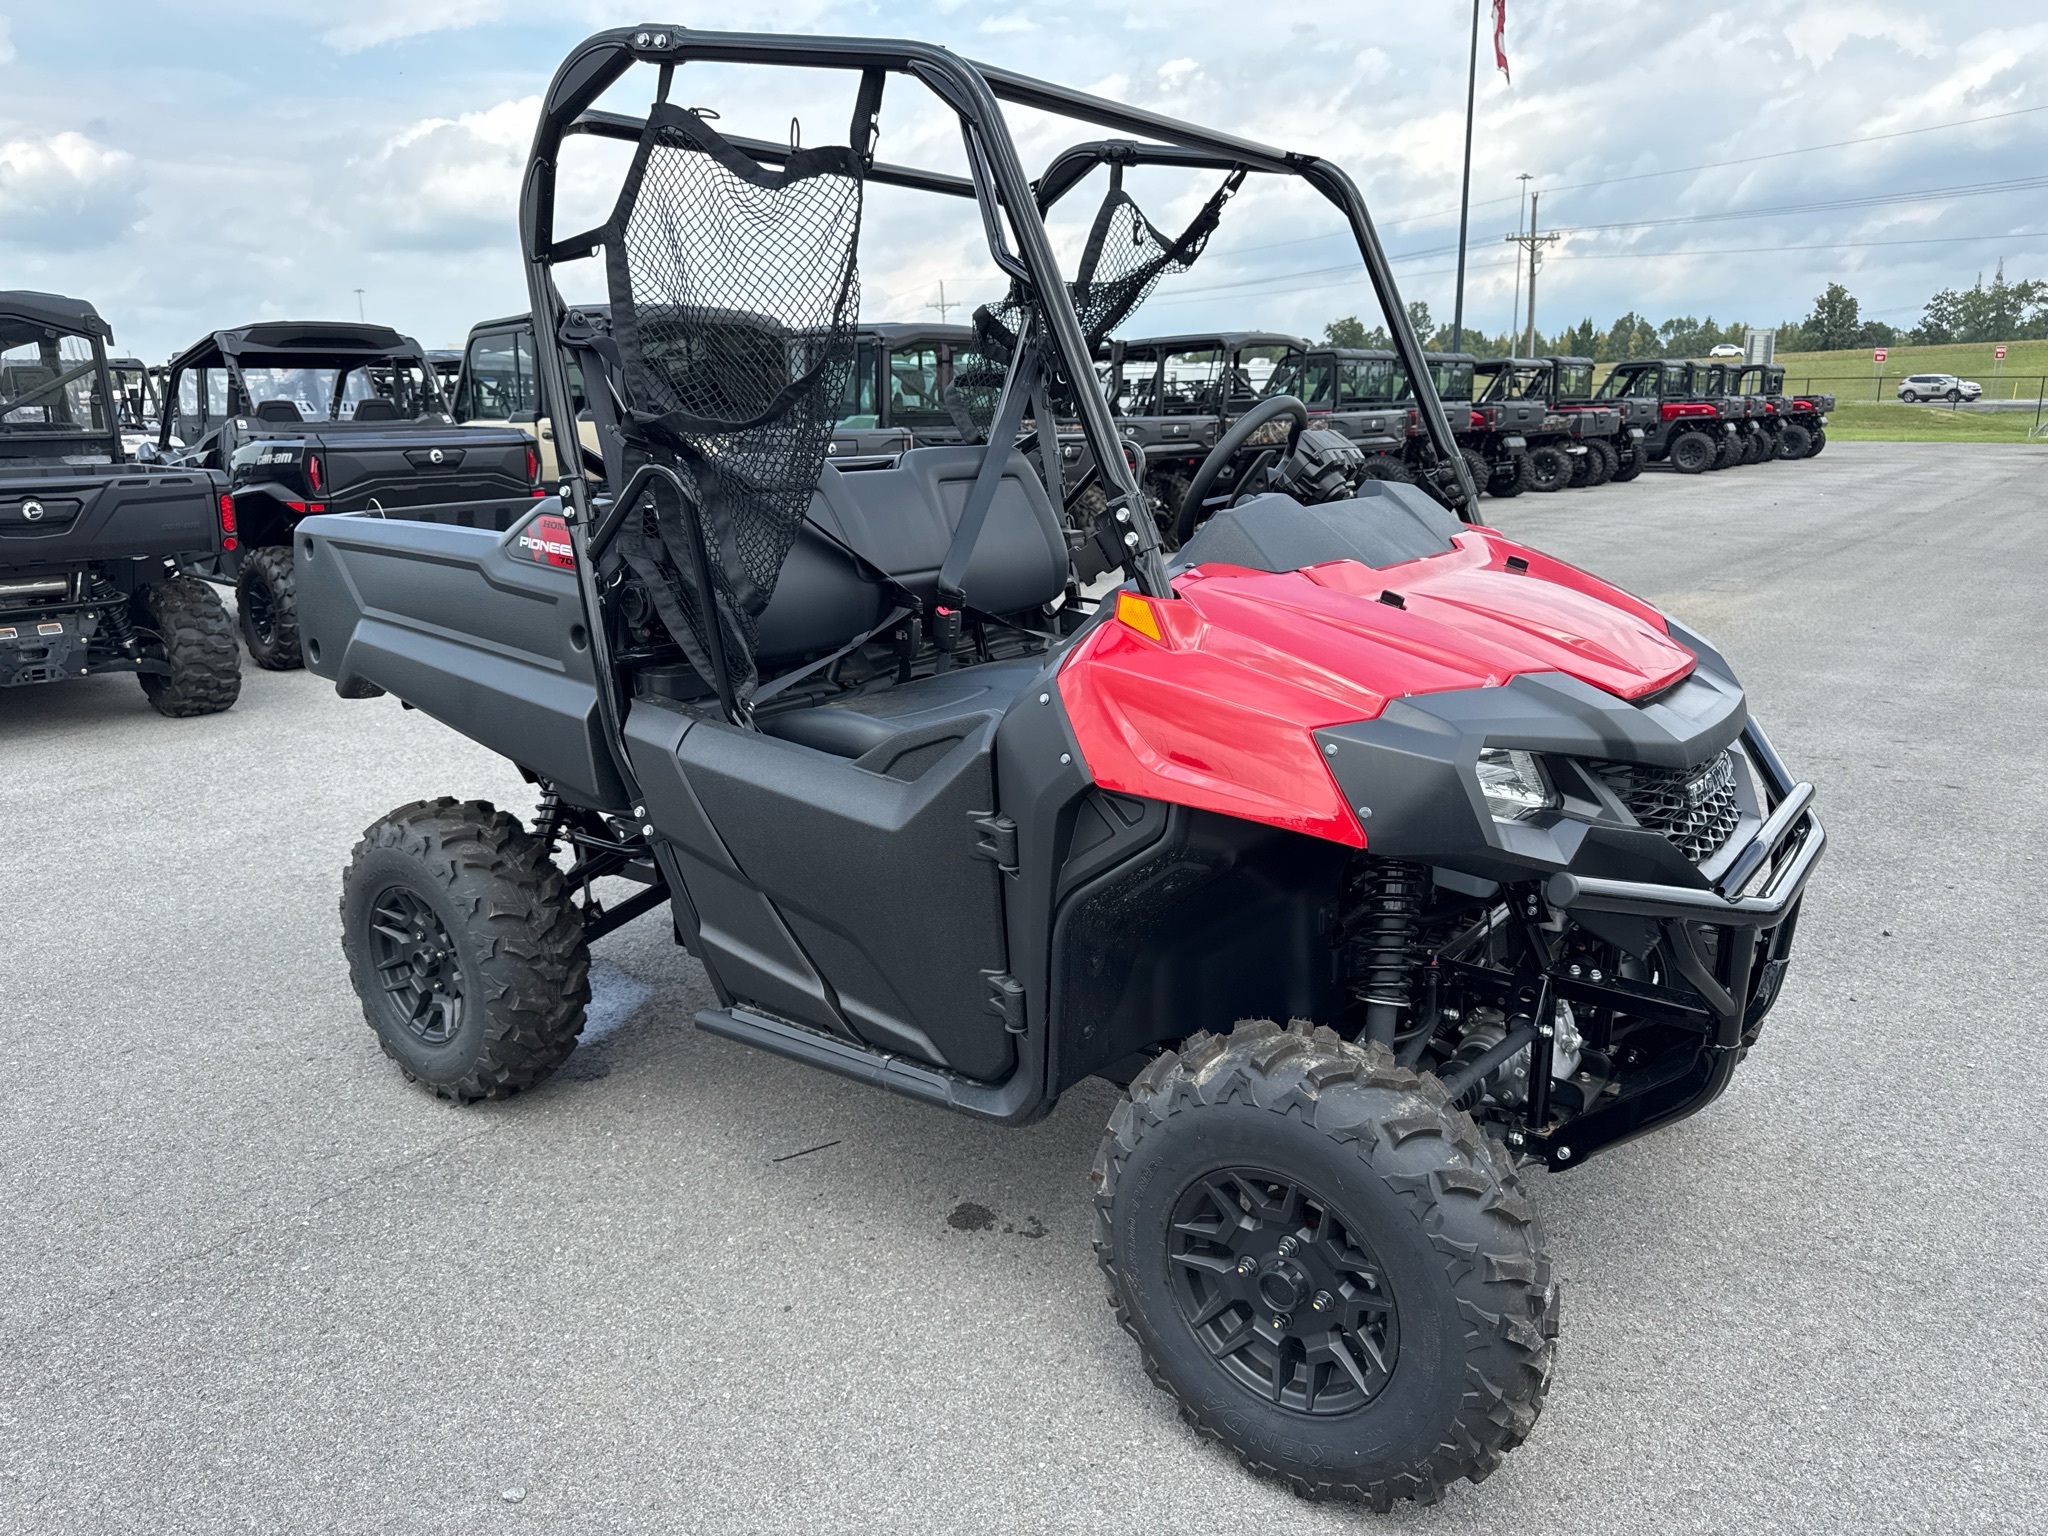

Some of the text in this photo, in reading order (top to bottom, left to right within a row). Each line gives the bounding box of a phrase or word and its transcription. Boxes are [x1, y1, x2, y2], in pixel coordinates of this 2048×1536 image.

[543, 520, 568, 532] HON
[519, 535, 573, 557] PIONEE
[559, 556, 574, 566] 70
[1201, 1387, 1334, 1469] KENDA
